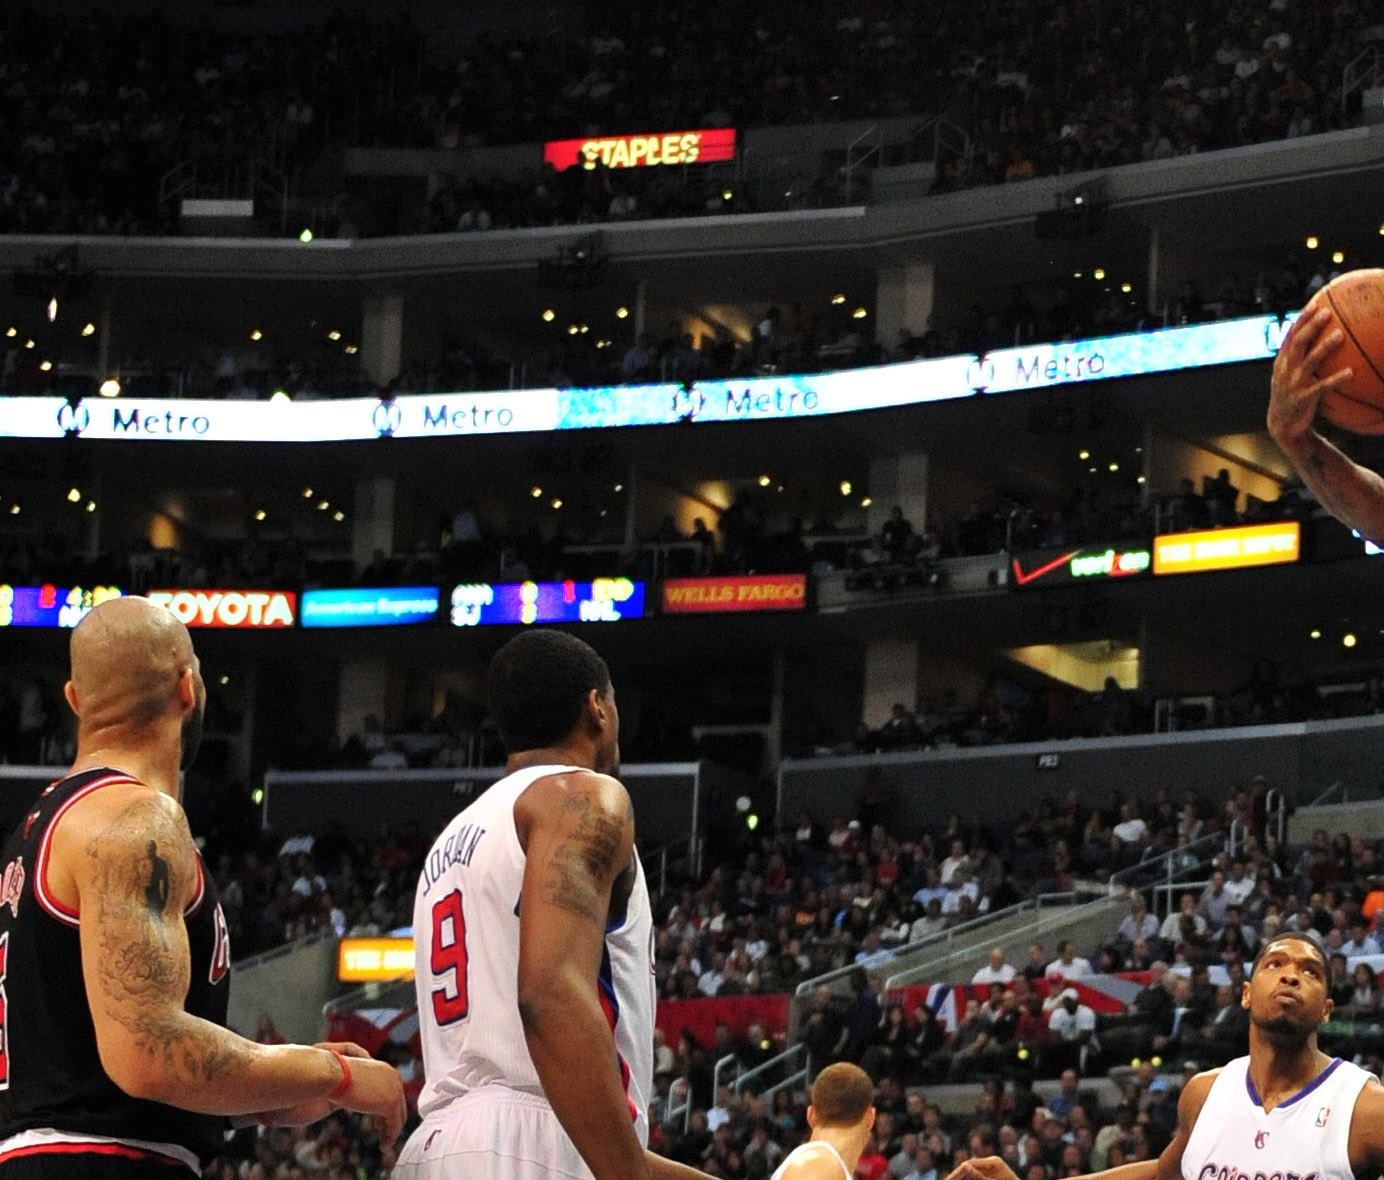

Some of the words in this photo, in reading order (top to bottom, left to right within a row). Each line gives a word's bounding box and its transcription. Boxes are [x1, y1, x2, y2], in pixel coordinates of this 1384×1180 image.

[581, 134, 701, 170] STAPLES
[1016, 350, 1106, 384] Metro
[423, 403, 514, 430] Metro
[725, 387, 819, 415] Metro
[113, 408, 210, 435] Metro
[148, 591, 293, 625] TOYOTA
[666, 585, 734, 604] WELLS
[738, 582, 806, 602] FARGO
[431, 888, 469, 1027] 9
